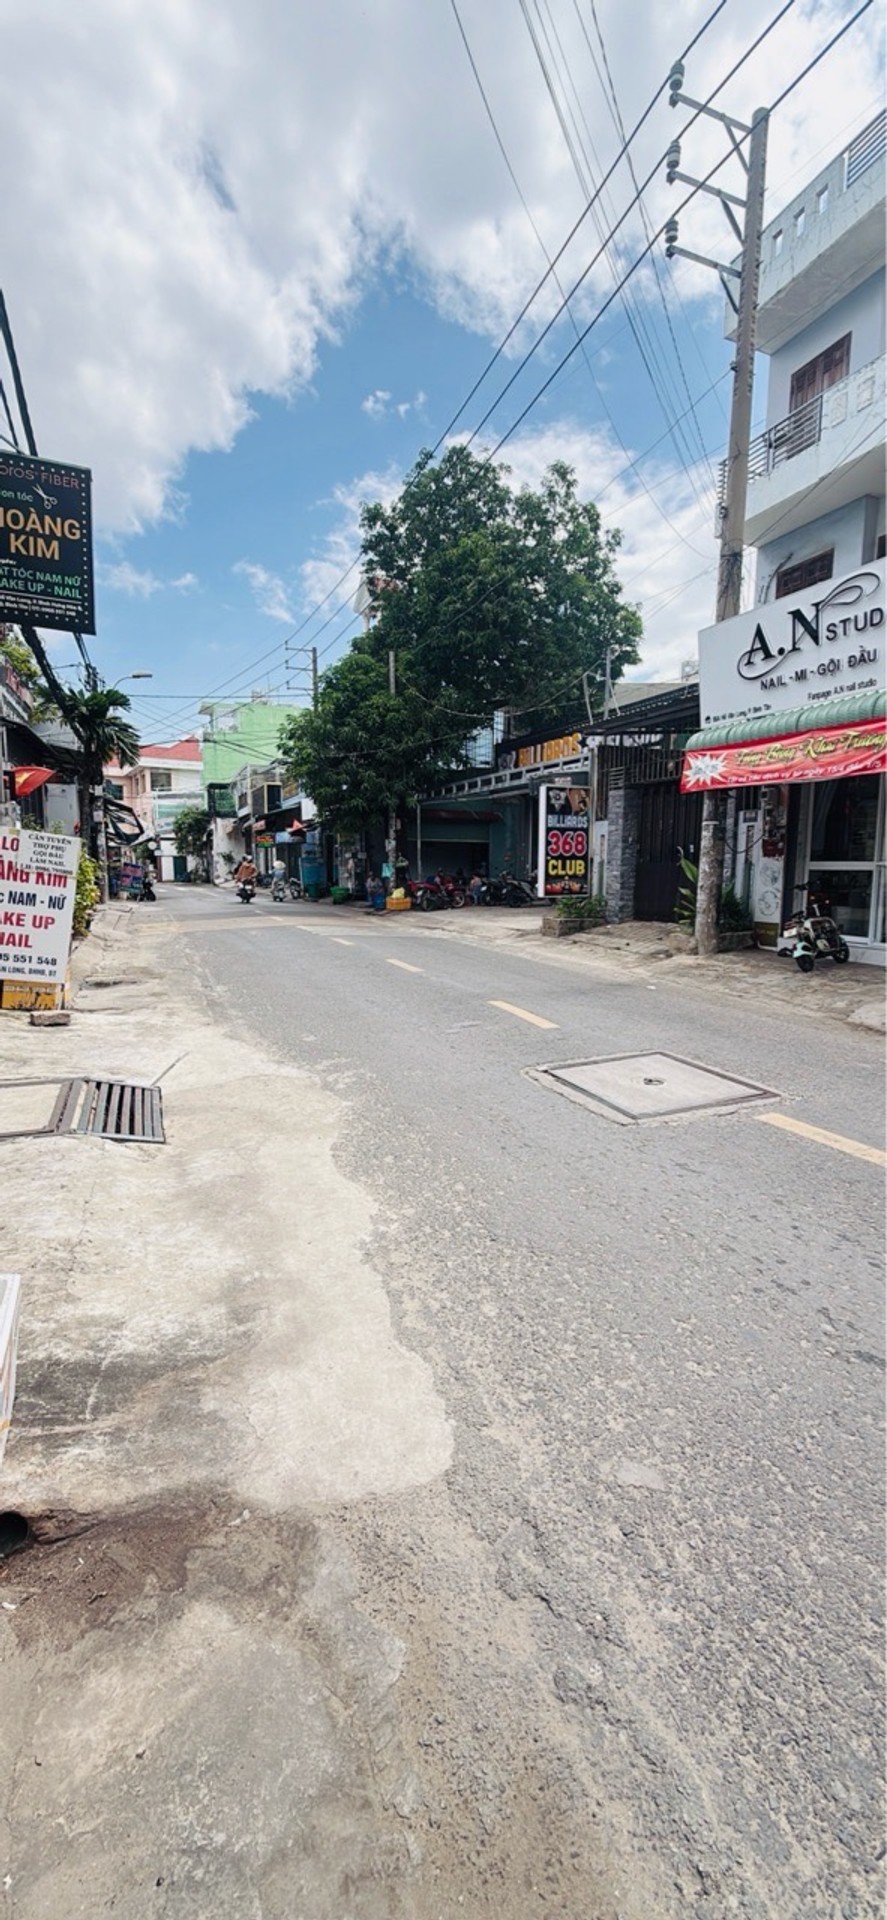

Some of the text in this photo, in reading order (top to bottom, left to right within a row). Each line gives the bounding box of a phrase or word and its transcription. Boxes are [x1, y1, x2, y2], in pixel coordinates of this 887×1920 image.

[41, 472, 80, 489] FIBER
[0, 506, 81, 540] OÀNG
[9, 532, 60, 560] KIM
[36, 571, 63, 584] NAM
[0, 577, 26, 591] AKE
[27, 581, 45, 593] UP
[54, 585, 82, 599] NAIL
[761, 676, 788, 691] NAIL
[794, 668, 808, 682] MI
[847, 645, 878, 668] ĐẦU
[547, 815, 588, 829] BILLIARDS
[548, 830, 587, 856] 368
[548, 859, 585, 876] CLUB
[35, 871, 68, 888] KIM
[8, 890, 37, 907] NAM
[48, 893, 67, 910] NỮ
[0, 911, 55, 929] KE UP
[13, 954, 32, 964] 551
